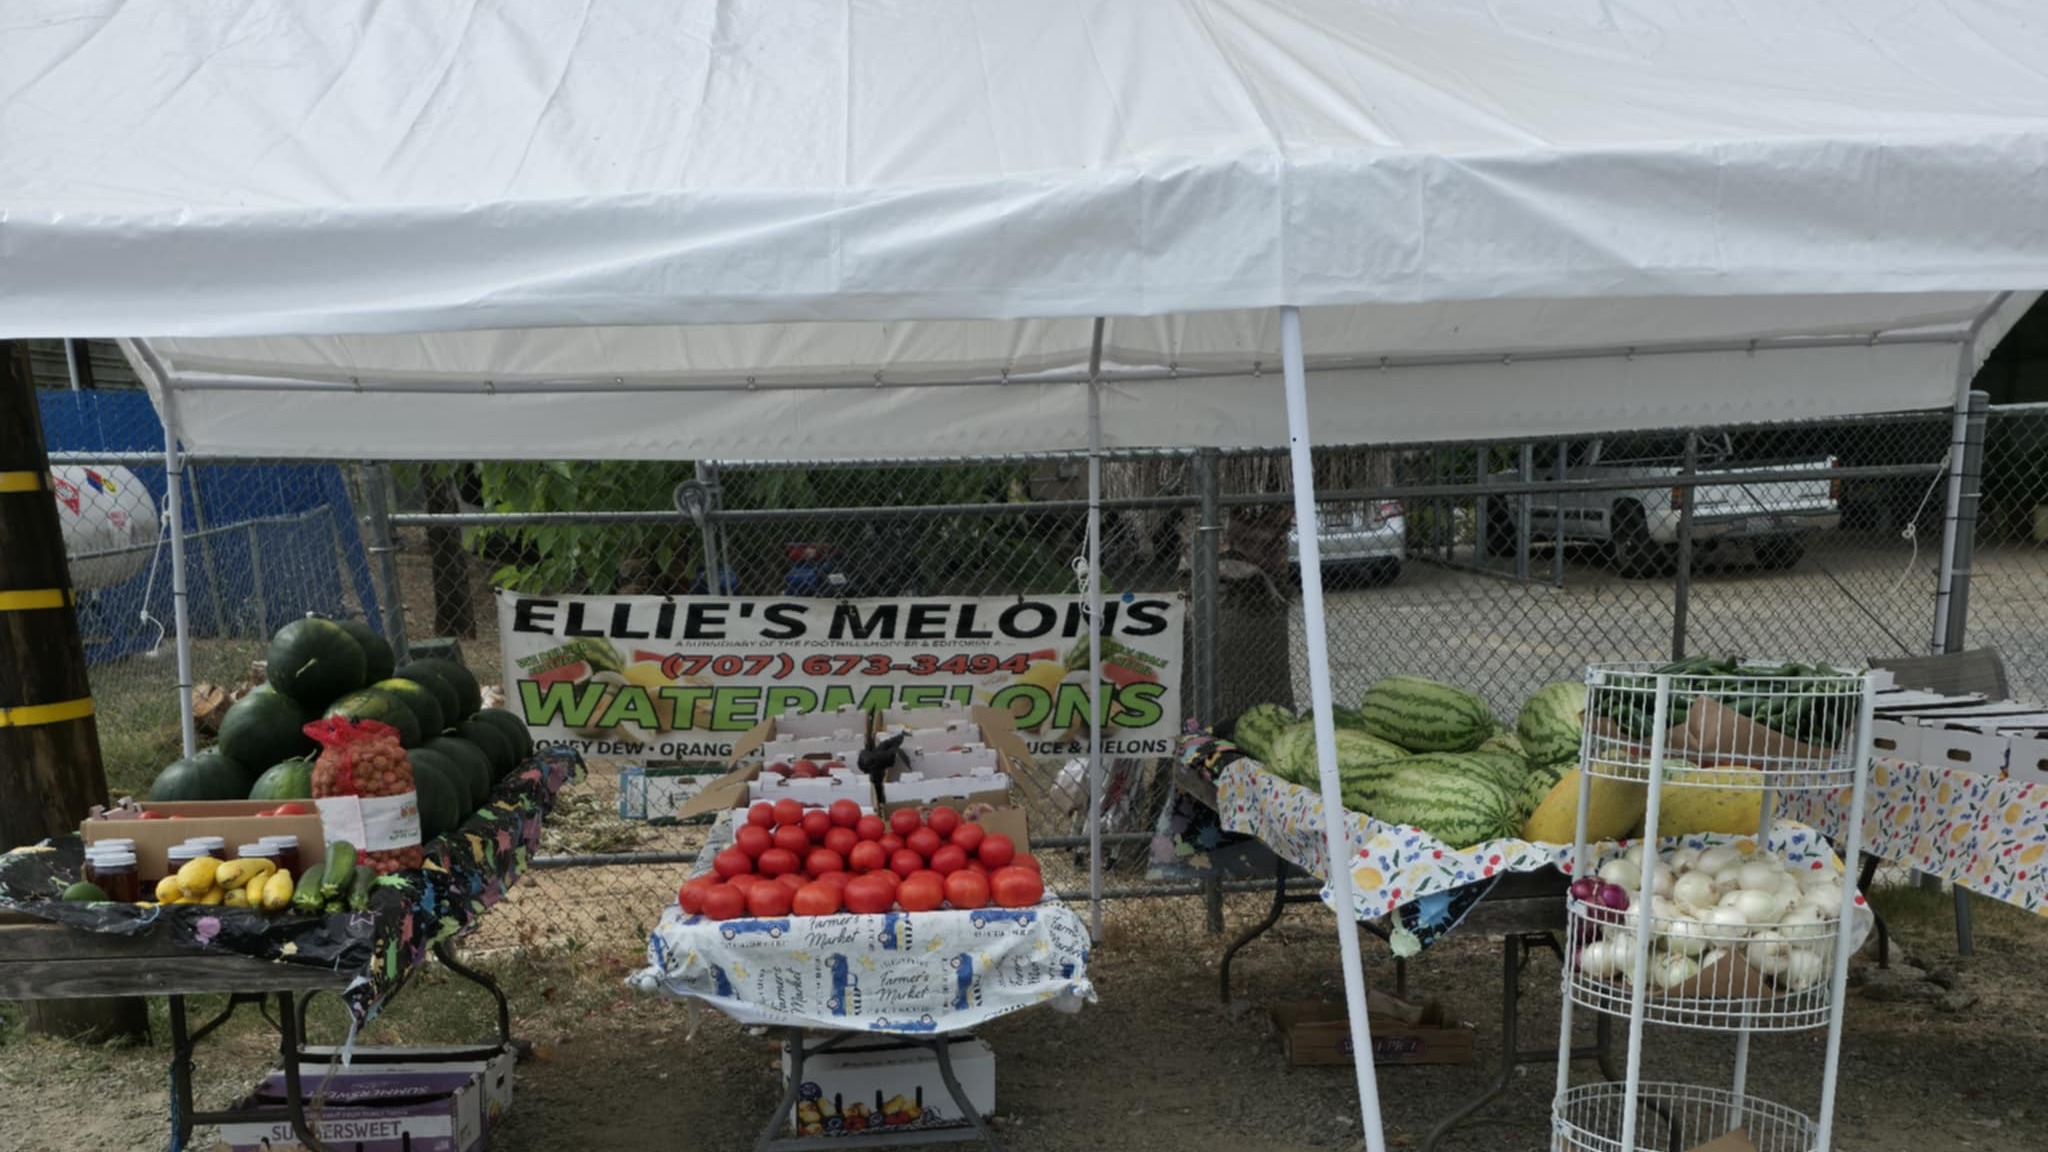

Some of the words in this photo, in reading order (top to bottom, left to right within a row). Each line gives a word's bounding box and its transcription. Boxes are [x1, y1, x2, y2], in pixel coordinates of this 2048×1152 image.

[513, 598, 810, 639] ELLIE'S
[828, 600, 1171, 639] MELONS
[778, 640, 801, 648] THE
[661, 652, 795, 681] (707)
[801, 652, 1031, 676] 673-3494
[598, 741, 646, 756] DEW
[660, 742, 733, 758] ORANG
[1067, 741, 1083, 755] &
[808, 915, 861, 931] Farmer's
[805, 929, 860, 949] Market
[879, 969, 929, 987] Farmer's
[875, 984, 929, 1004] Market
[272, 1120, 402, 1141] SUERSWEET
